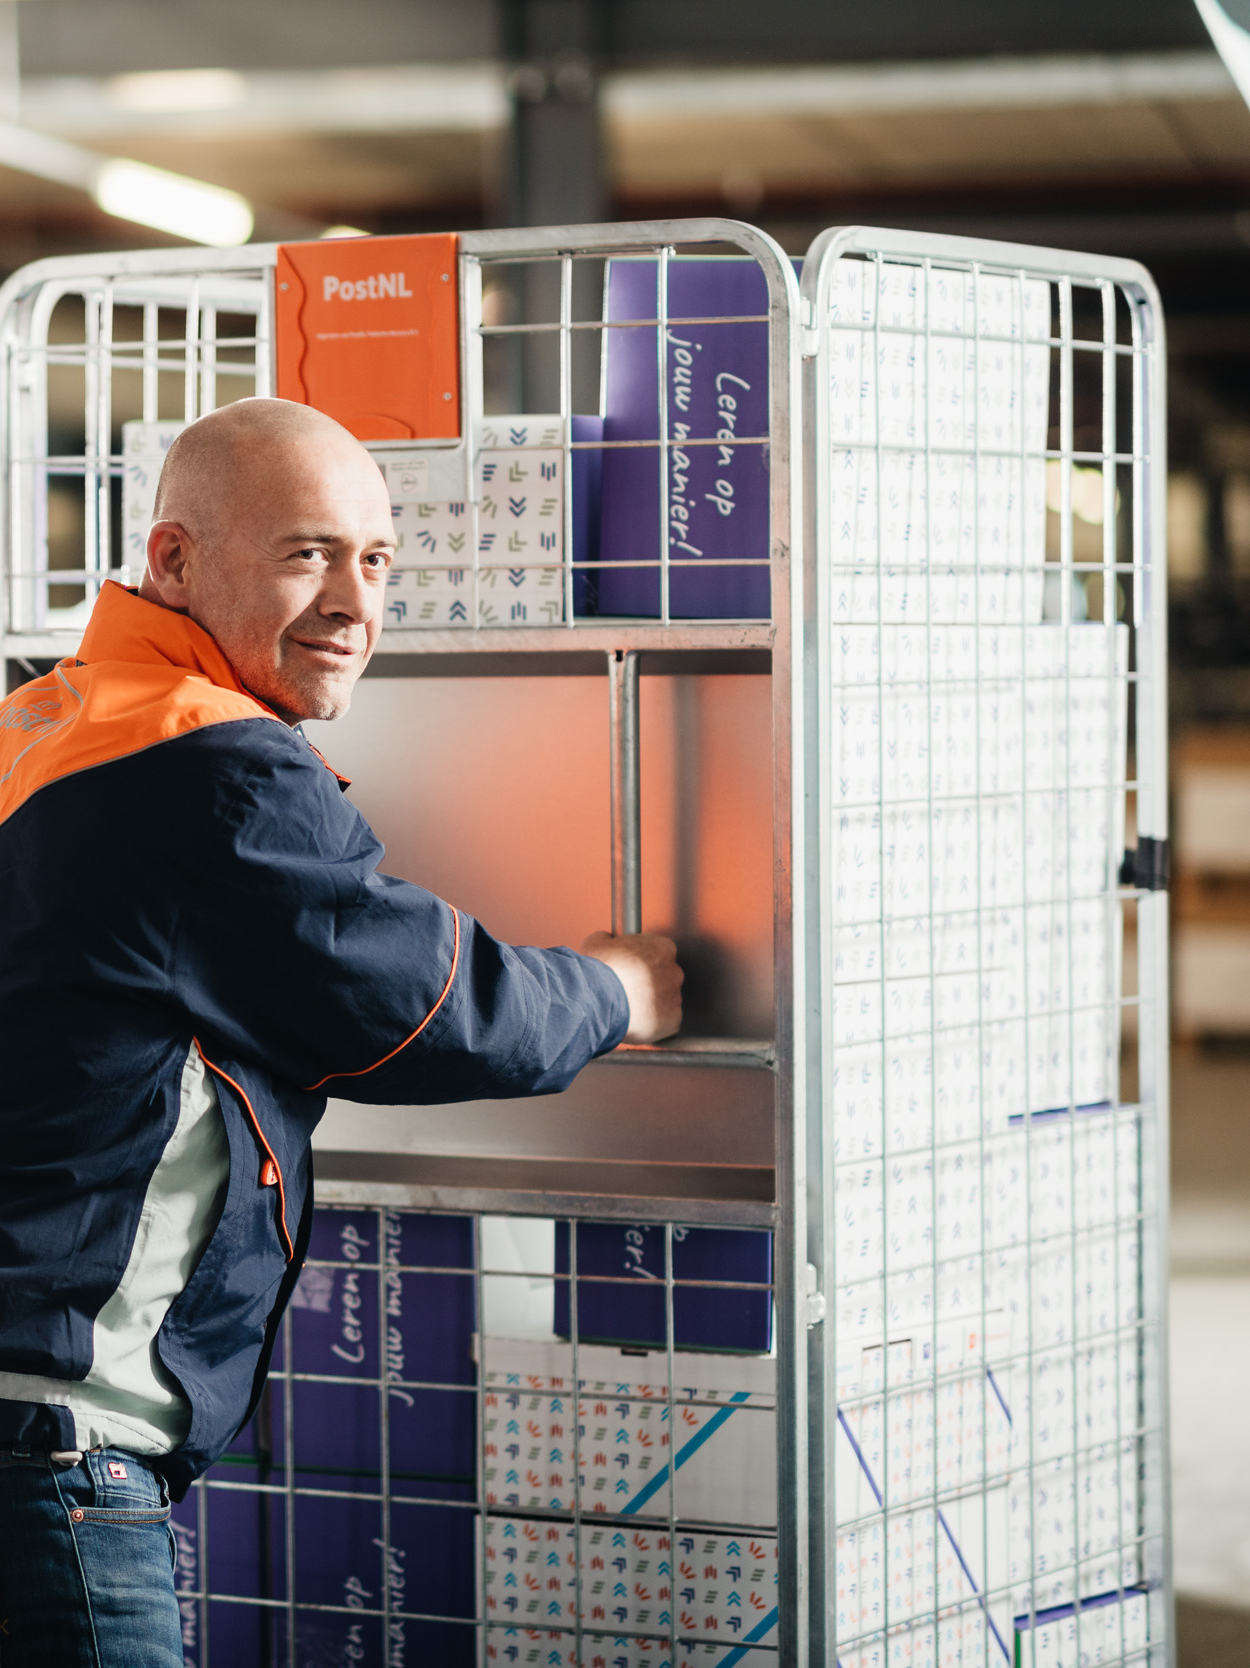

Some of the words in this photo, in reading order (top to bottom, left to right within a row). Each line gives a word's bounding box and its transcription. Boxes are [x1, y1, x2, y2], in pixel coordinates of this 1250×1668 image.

[322, 272, 413, 301] PostNL
[666, 328, 703, 412] jouw
[715, 371, 751, 466] Leren
[669, 421, 703, 557] manier!
[704, 479, 736, 516] op
[341, 1224, 370, 1260] op
[331, 1272, 365, 1363] Leren
[344, 1576, 373, 1611] op
